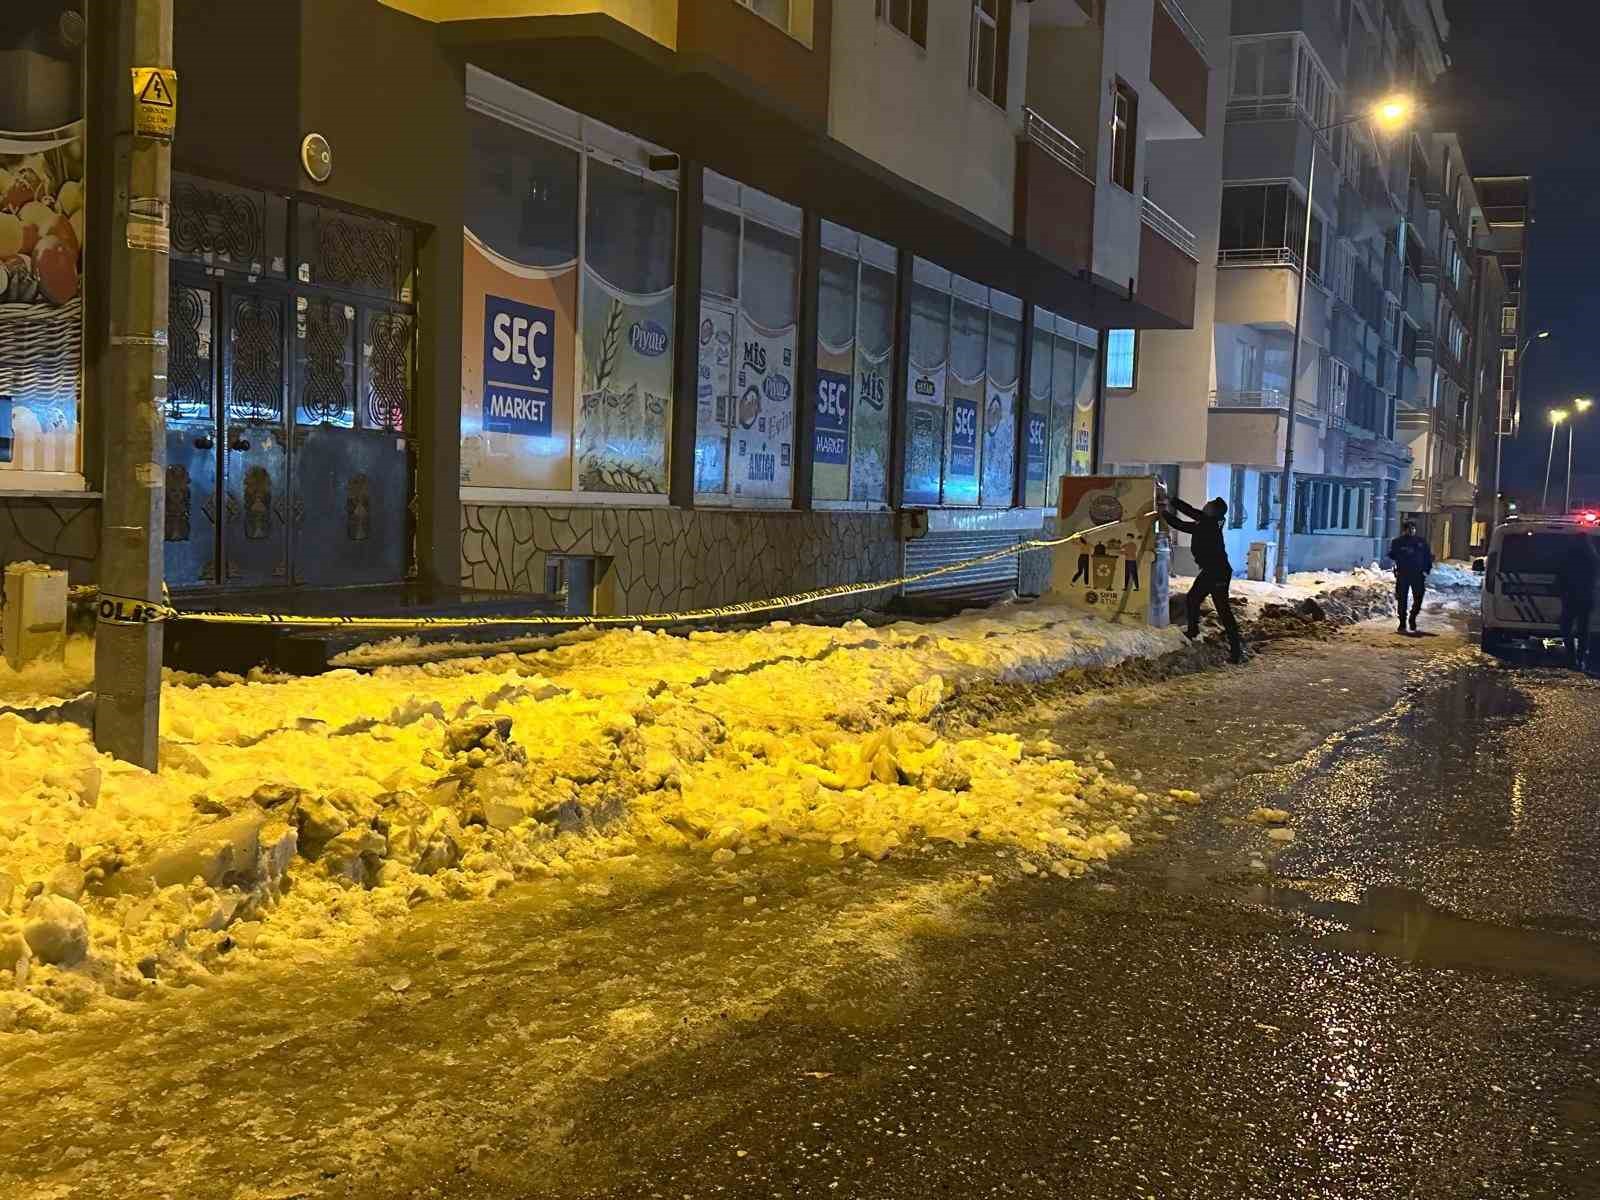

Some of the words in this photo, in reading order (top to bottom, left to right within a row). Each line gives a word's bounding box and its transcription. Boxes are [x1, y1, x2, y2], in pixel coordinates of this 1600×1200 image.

[492, 312, 547, 381] SEÇ
[490, 394, 546, 422] MARKET
[818, 380, 847, 425] SEÇ
[955, 406, 975, 443] SEÇ
[816, 435, 845, 454] MARKET
